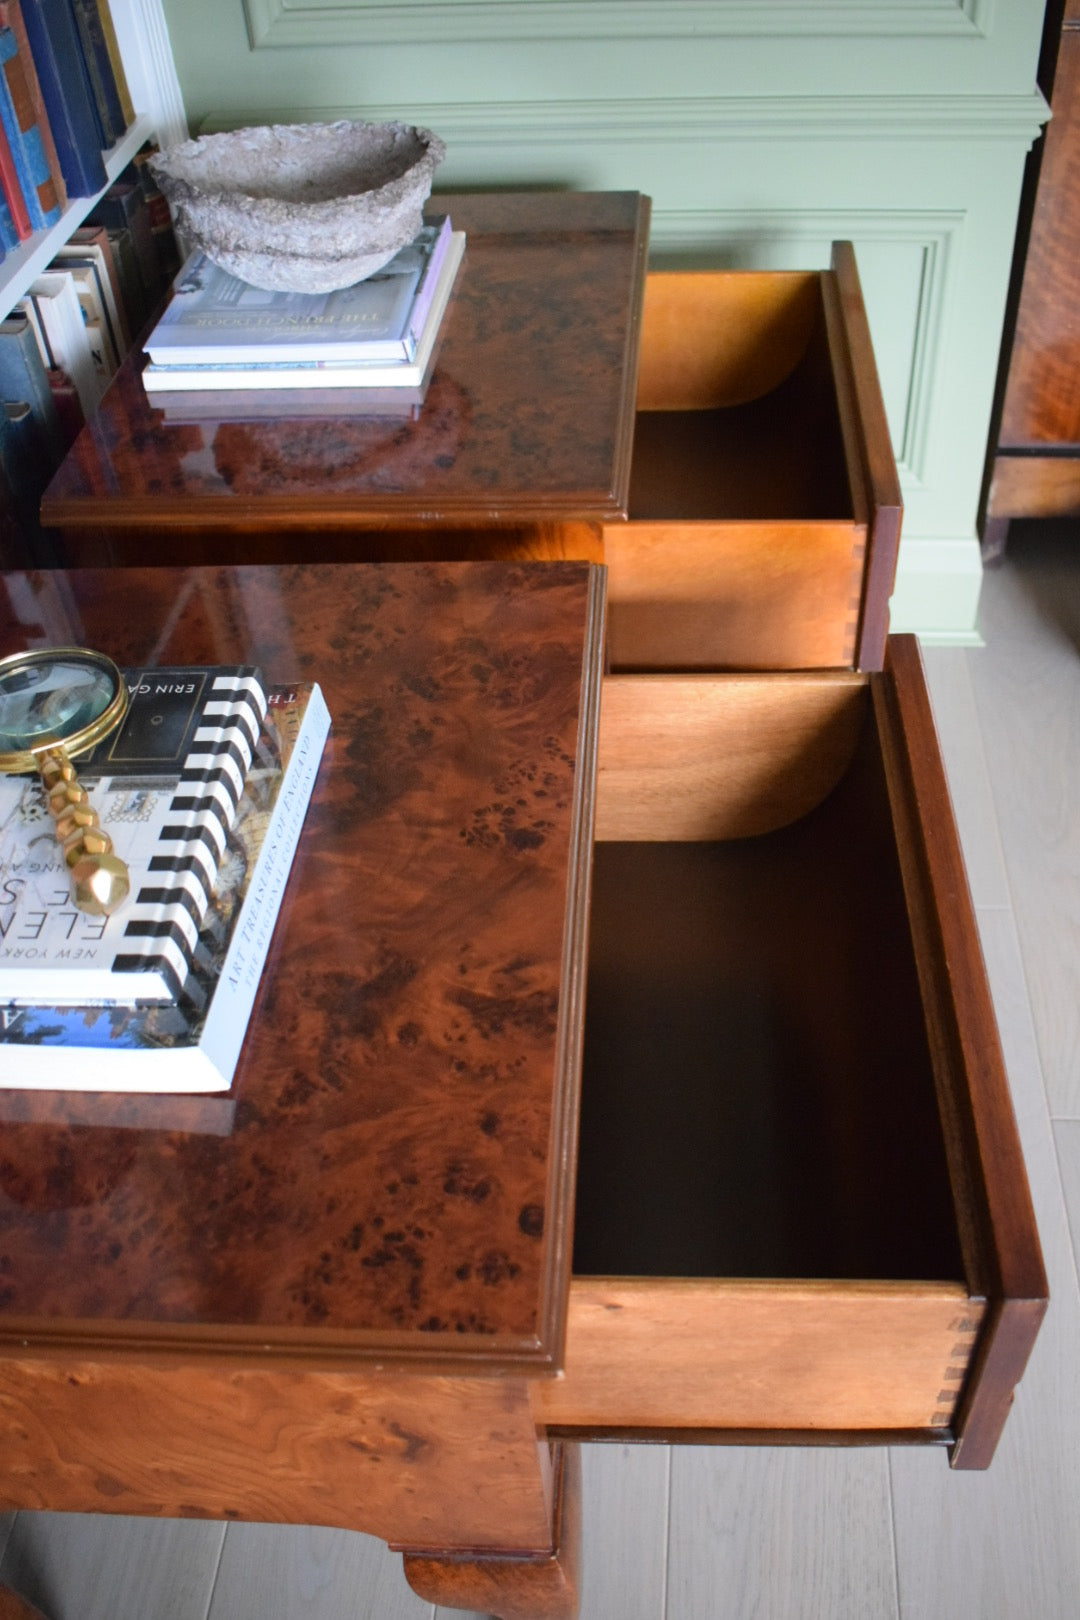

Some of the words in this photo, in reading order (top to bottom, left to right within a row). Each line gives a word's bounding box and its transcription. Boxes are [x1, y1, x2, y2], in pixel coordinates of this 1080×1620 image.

[195, 318, 250, 327] DOOR
[256, 315, 335, 326] FRENCH
[156, 684, 195, 694] ERIN
[227, 945, 245, 995] ART
[239, 839, 277, 944] TREASURES
[282, 733, 309, 812] ENGLAND
[1, 948, 48, 959] YORK
[54, 949, 97, 960] NEW
